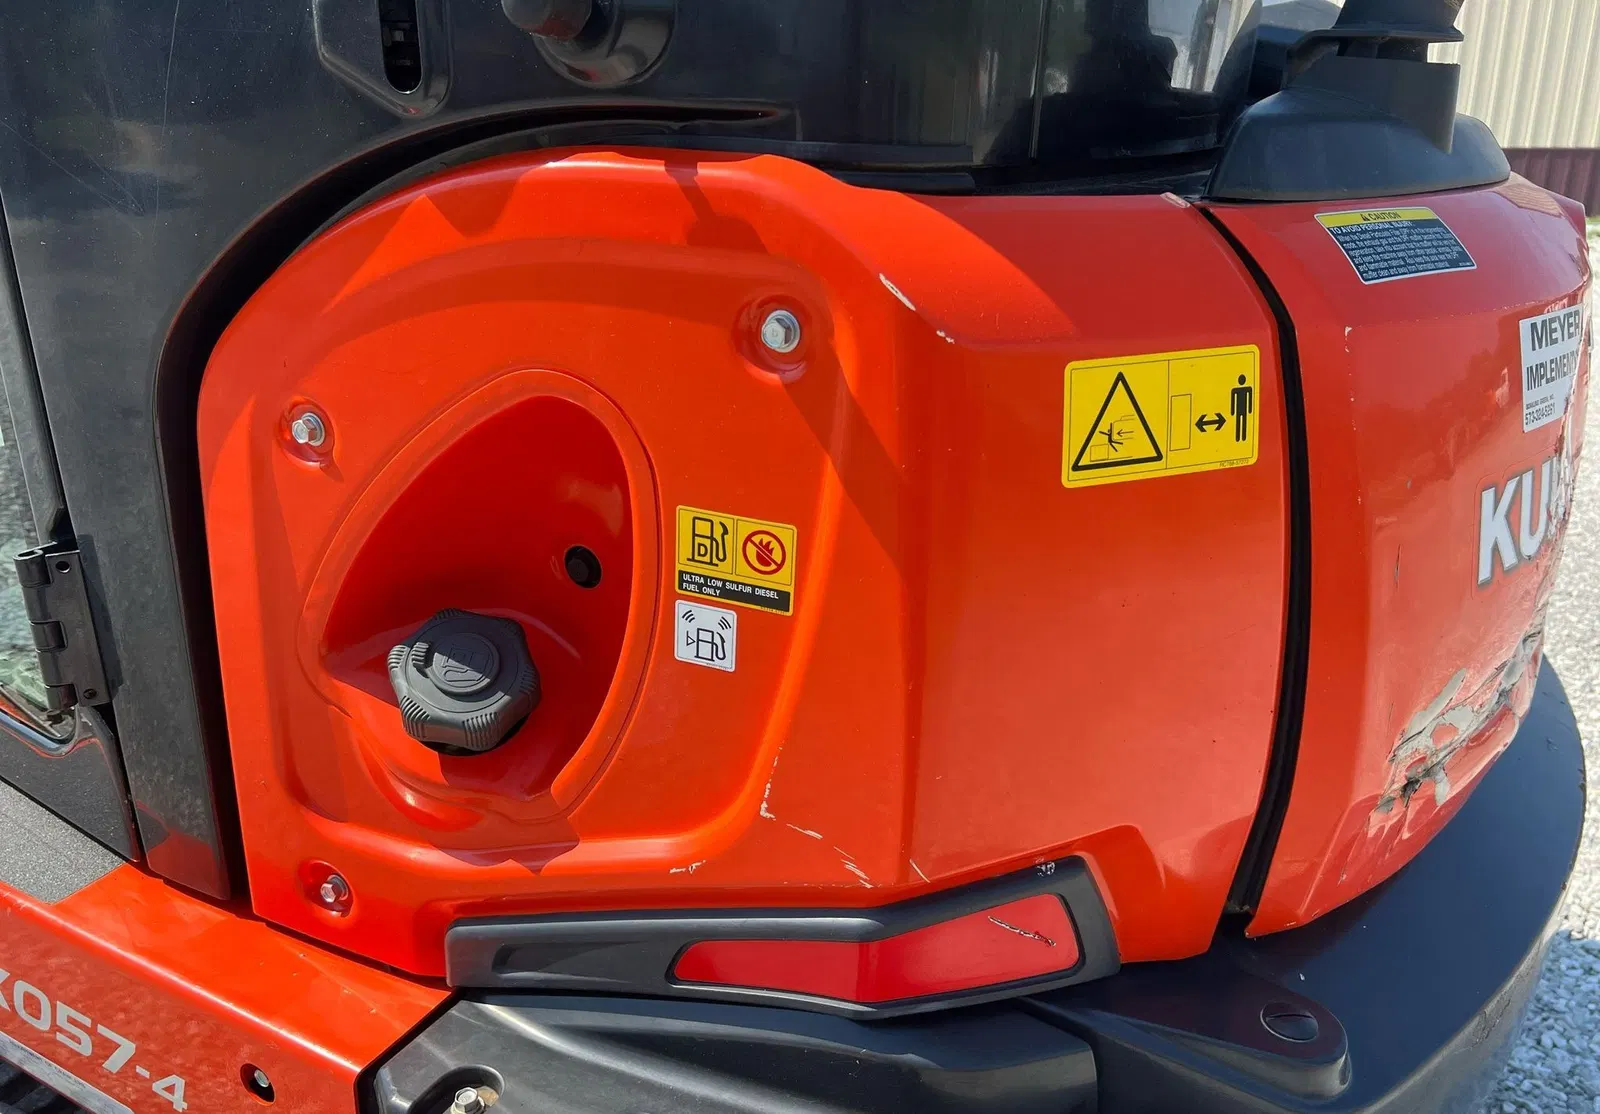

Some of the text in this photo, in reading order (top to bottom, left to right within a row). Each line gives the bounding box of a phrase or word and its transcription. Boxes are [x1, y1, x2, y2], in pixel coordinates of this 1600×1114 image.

[1368, 211, 1401, 220] CAUTION
[1530, 310, 1580, 351] MEYER
[697, 542, 708, 558] D
[683, 573, 779, 599] ULTRA LOW SULFUR DIESEL
[683, 582, 720, 597] FUEL ONLY
